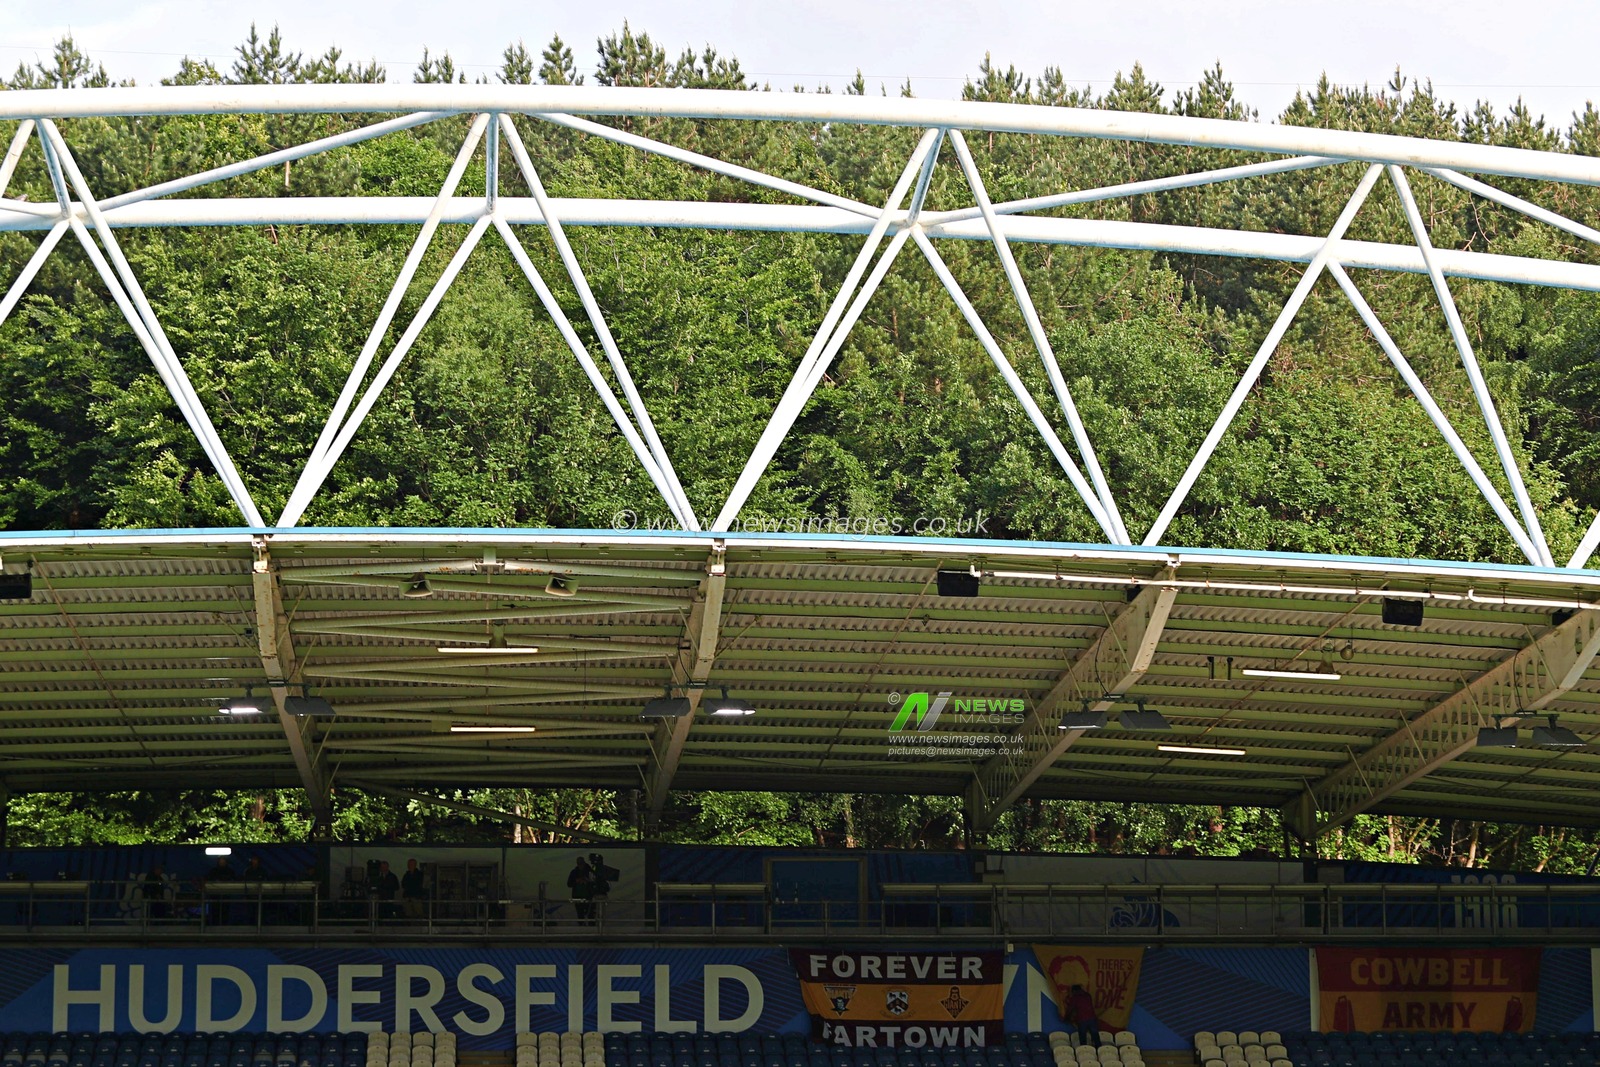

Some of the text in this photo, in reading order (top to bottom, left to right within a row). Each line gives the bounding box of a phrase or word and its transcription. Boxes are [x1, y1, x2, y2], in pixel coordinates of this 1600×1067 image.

[809, 954, 984, 980] FOREVER
[1096, 958, 1135, 970] THERE'S
[1350, 957, 1509, 986] COWBELL
[1095, 970, 1132, 992] ONLY
[52, 962, 765, 1036] HUDDERSFIELD
[1382, 1002, 1478, 1029] ARMY
